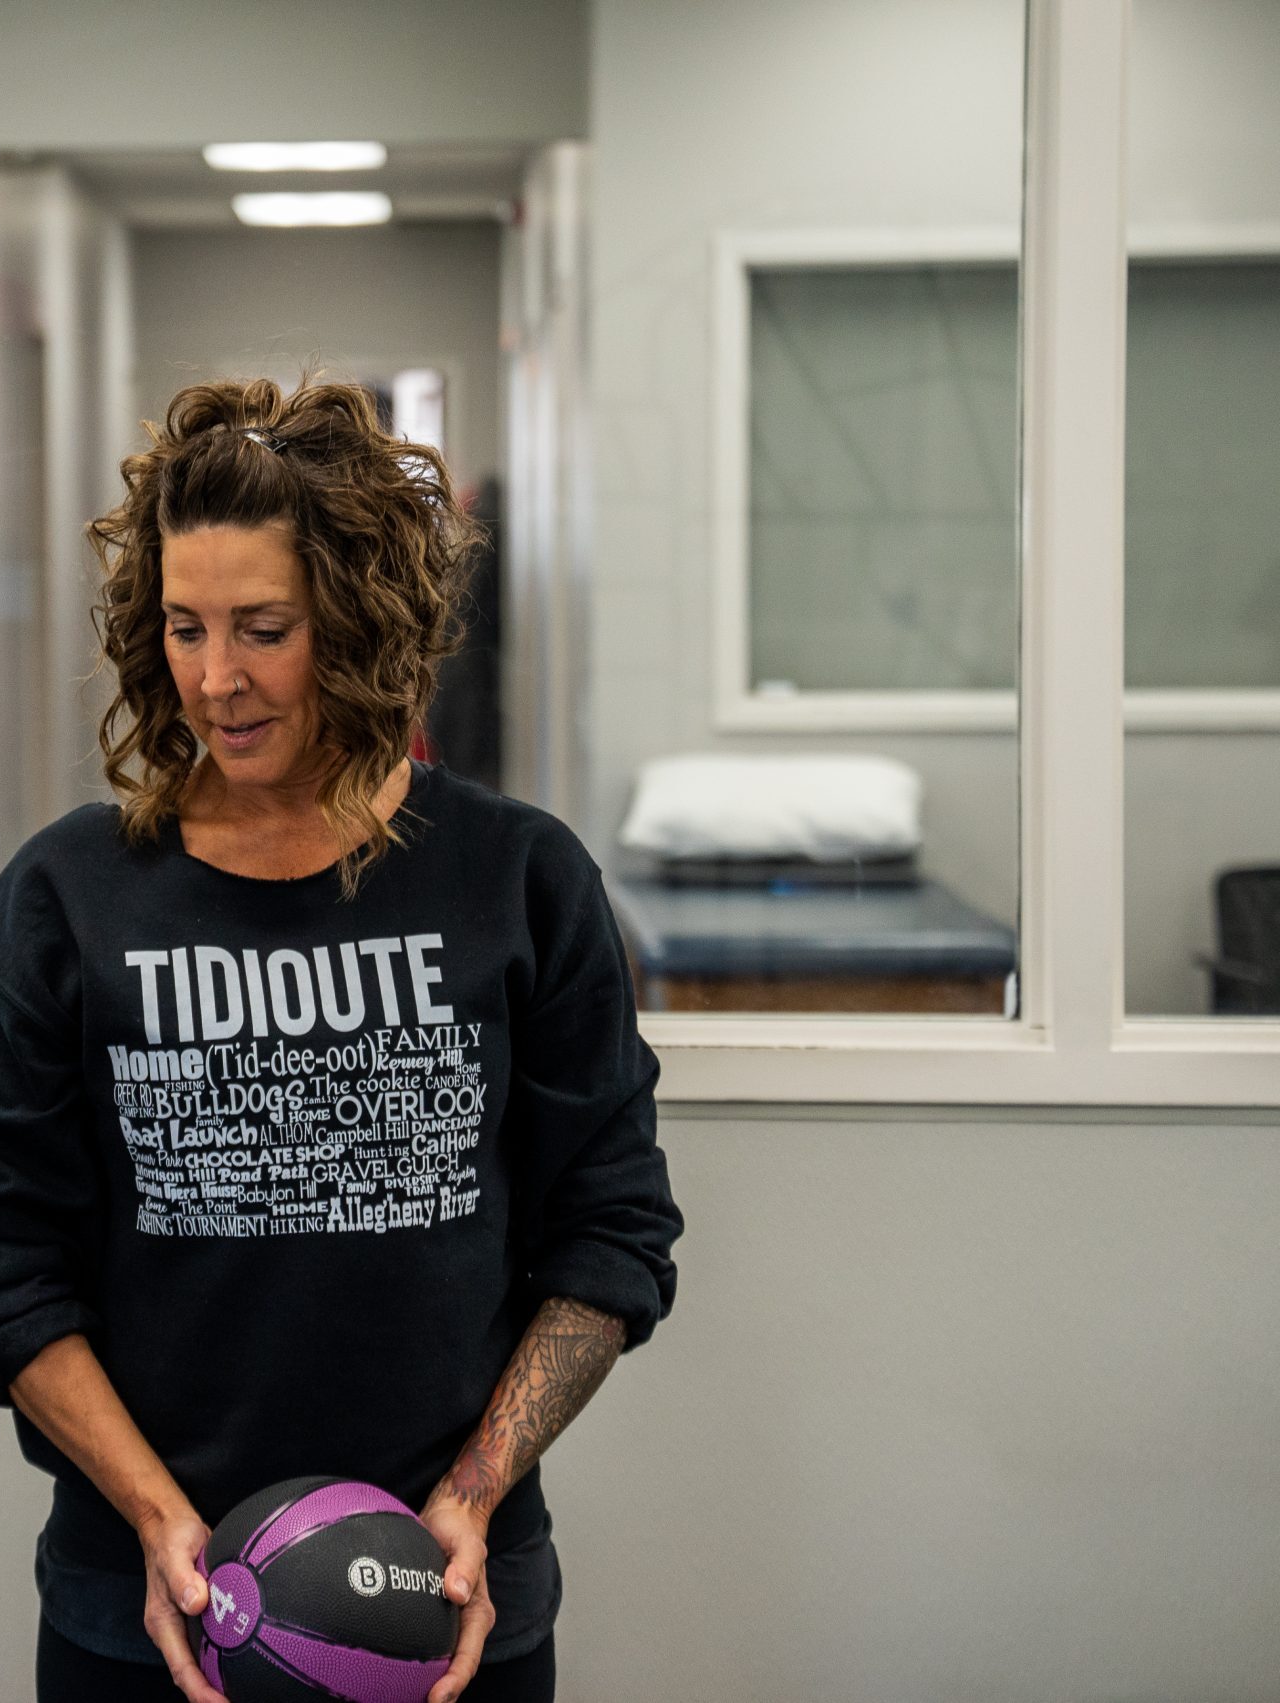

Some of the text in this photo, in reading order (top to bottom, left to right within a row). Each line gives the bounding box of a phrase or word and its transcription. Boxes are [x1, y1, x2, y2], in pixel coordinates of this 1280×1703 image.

[125, 933, 454, 1044] TIDIOUTE
[374, 1023, 482, 1053] FAMILY
[107, 1045, 204, 1082] Home
[206, 1033, 377, 1091] (Tid-dee-oot)
[438, 1048, 464, 1068] Hill
[455, 1062, 482, 1075] HOME
[164, 1080, 205, 1092] FISHING
[310, 1070, 420, 1097] The cookie
[425, 1073, 478, 1090] CANOEING
[113, 1083, 155, 1107] CREEK RD.
[153, 1079, 305, 1124] BULLDOGS
[304, 1096, 338, 1105] family
[335, 1083, 487, 1125] OVERLOOK
[119, 1107, 155, 1118] CAMPING
[195, 1115, 225, 1129] family
[288, 1108, 331, 1123] HOME
[119, 1116, 164, 1150] Boat
[412, 1114, 481, 1134] DANCELAND
[315, 1120, 410, 1149] Campbell Hill
[156, 1150, 183, 1168] Park
[184, 1143, 346, 1169] CHOCOLATE SHOP
[354, 1145, 410, 1159] Hunting
[135, 1163, 216, 1183] Morrison Hill
[218, 1163, 309, 1183] Pond Path
[311, 1152, 459, 1183] GRAVEL GULCH
[337, 1180, 377, 1195] Family
[384, 1172, 440, 1189] RIVERSIDE
[404, 1184, 436, 1197] TRAIL
[164, 1182, 198, 1203] Opera
[200, 1181, 238, 1199] House
[238, 1180, 317, 1206] Babylon Hill
[179, 1199, 238, 1215] The Point
[272, 1201, 328, 1216] HOME
[327, 1185, 480, 1233] Allegheny River
[172, 1213, 268, 1237] TOURNAMENT
[270, 1217, 324, 1235] HIKING
[389, 1565, 426, 1592] BODY
[209, 1583, 236, 1624] 4
[233, 1614, 250, 1635] LB
